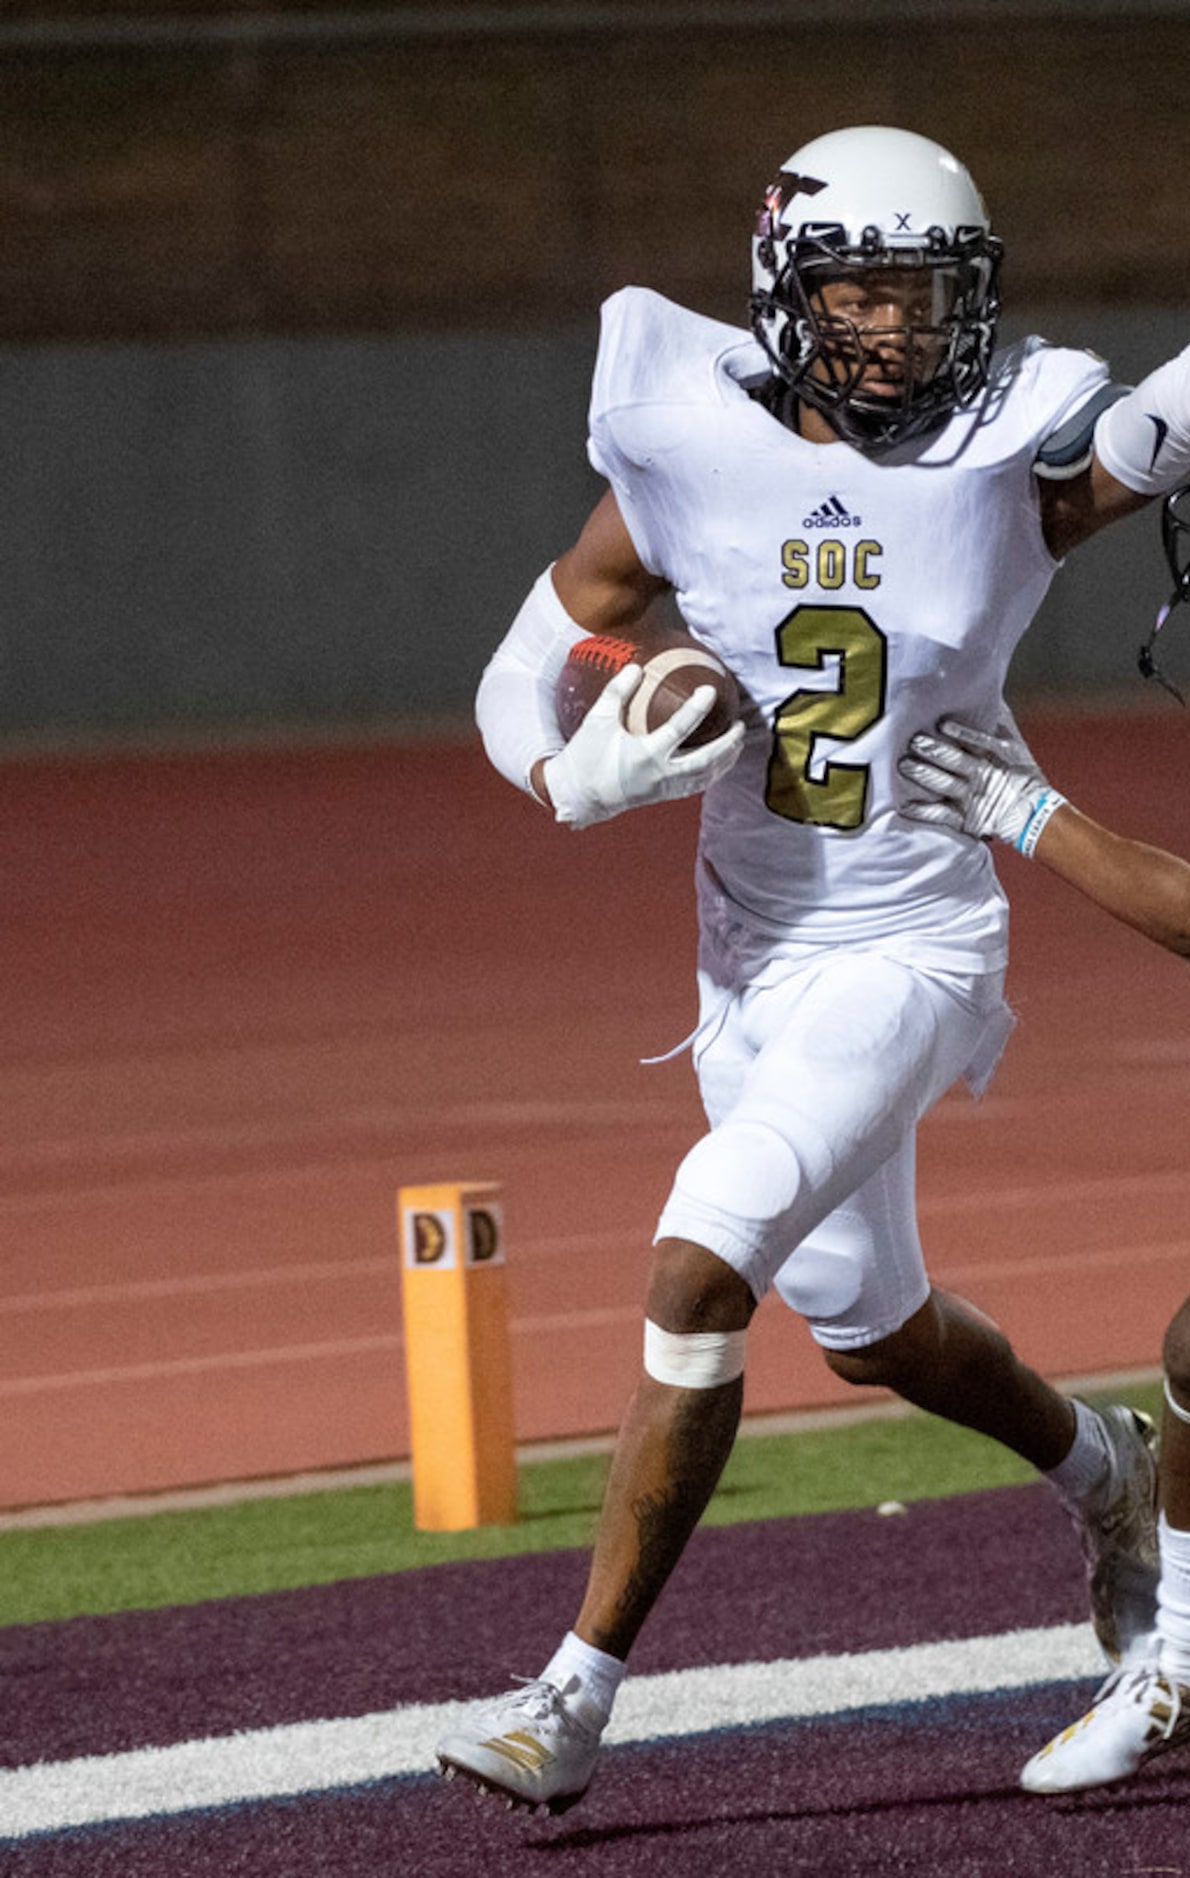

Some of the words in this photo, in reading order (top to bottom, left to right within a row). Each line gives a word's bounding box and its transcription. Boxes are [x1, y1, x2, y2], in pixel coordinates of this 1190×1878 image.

[802, 515, 862, 528] adidas
[781, 539, 883, 590] SOC
[765, 603, 888, 830] 2
